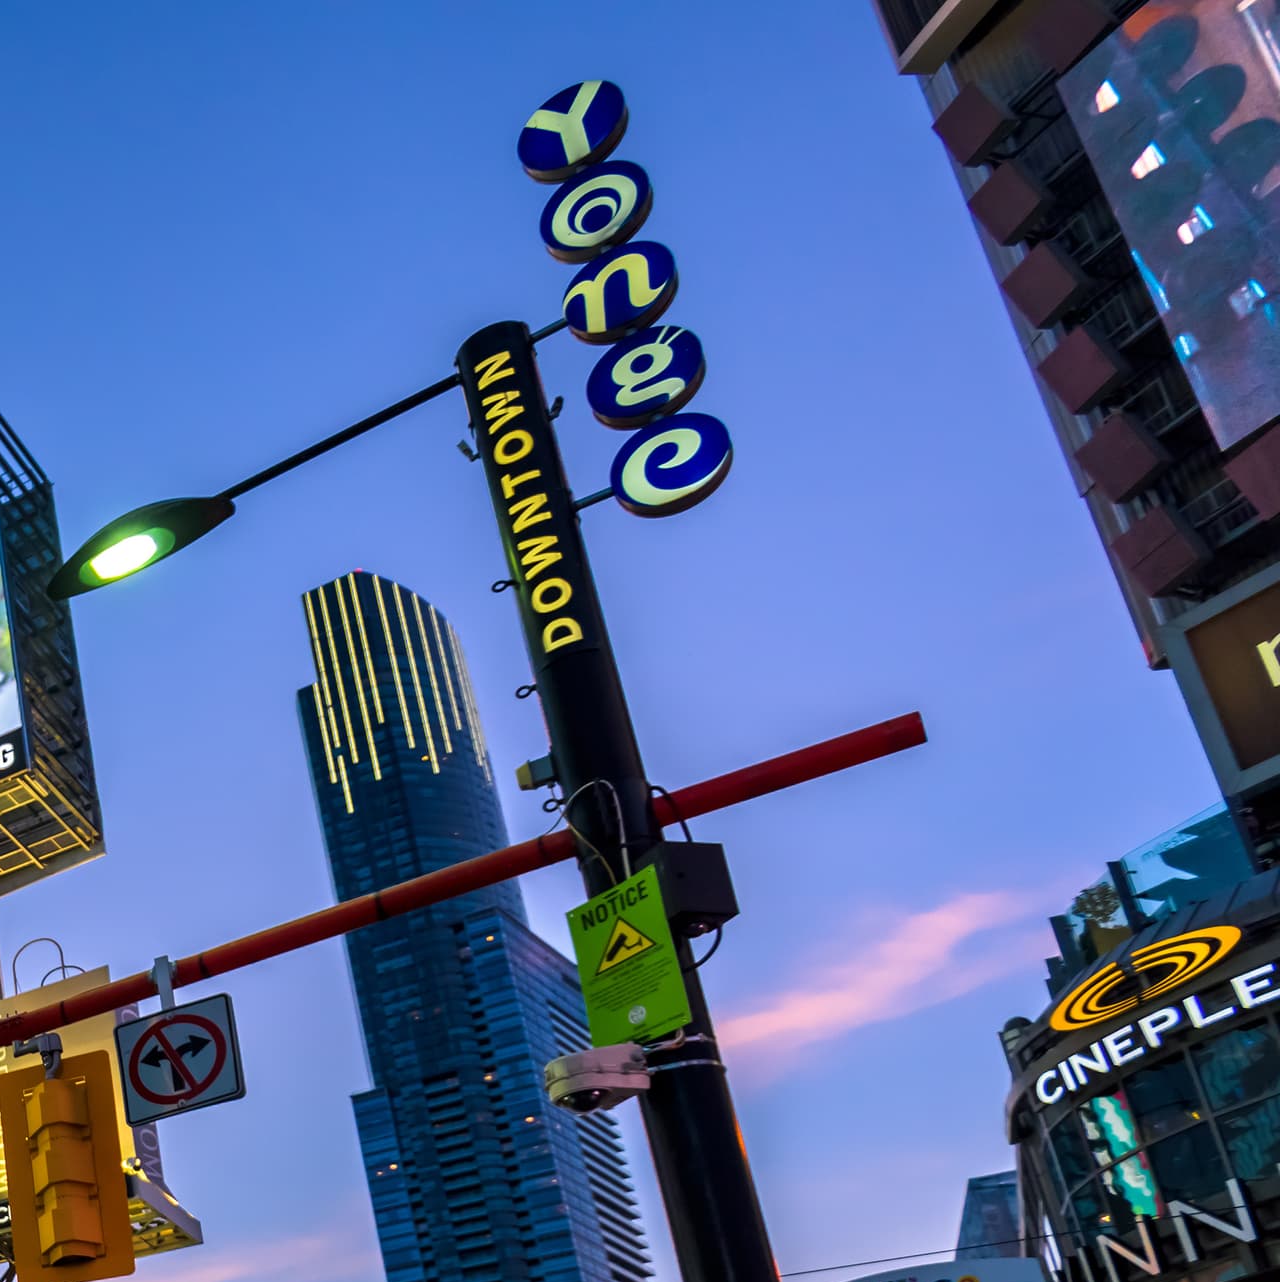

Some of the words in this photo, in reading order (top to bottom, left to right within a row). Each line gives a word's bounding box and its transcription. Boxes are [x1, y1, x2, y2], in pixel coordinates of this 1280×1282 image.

[525, 80, 730, 507] Yonge
[475, 350, 584, 653] DOWNTOWN
[581, 880, 648, 931] NOTICE
